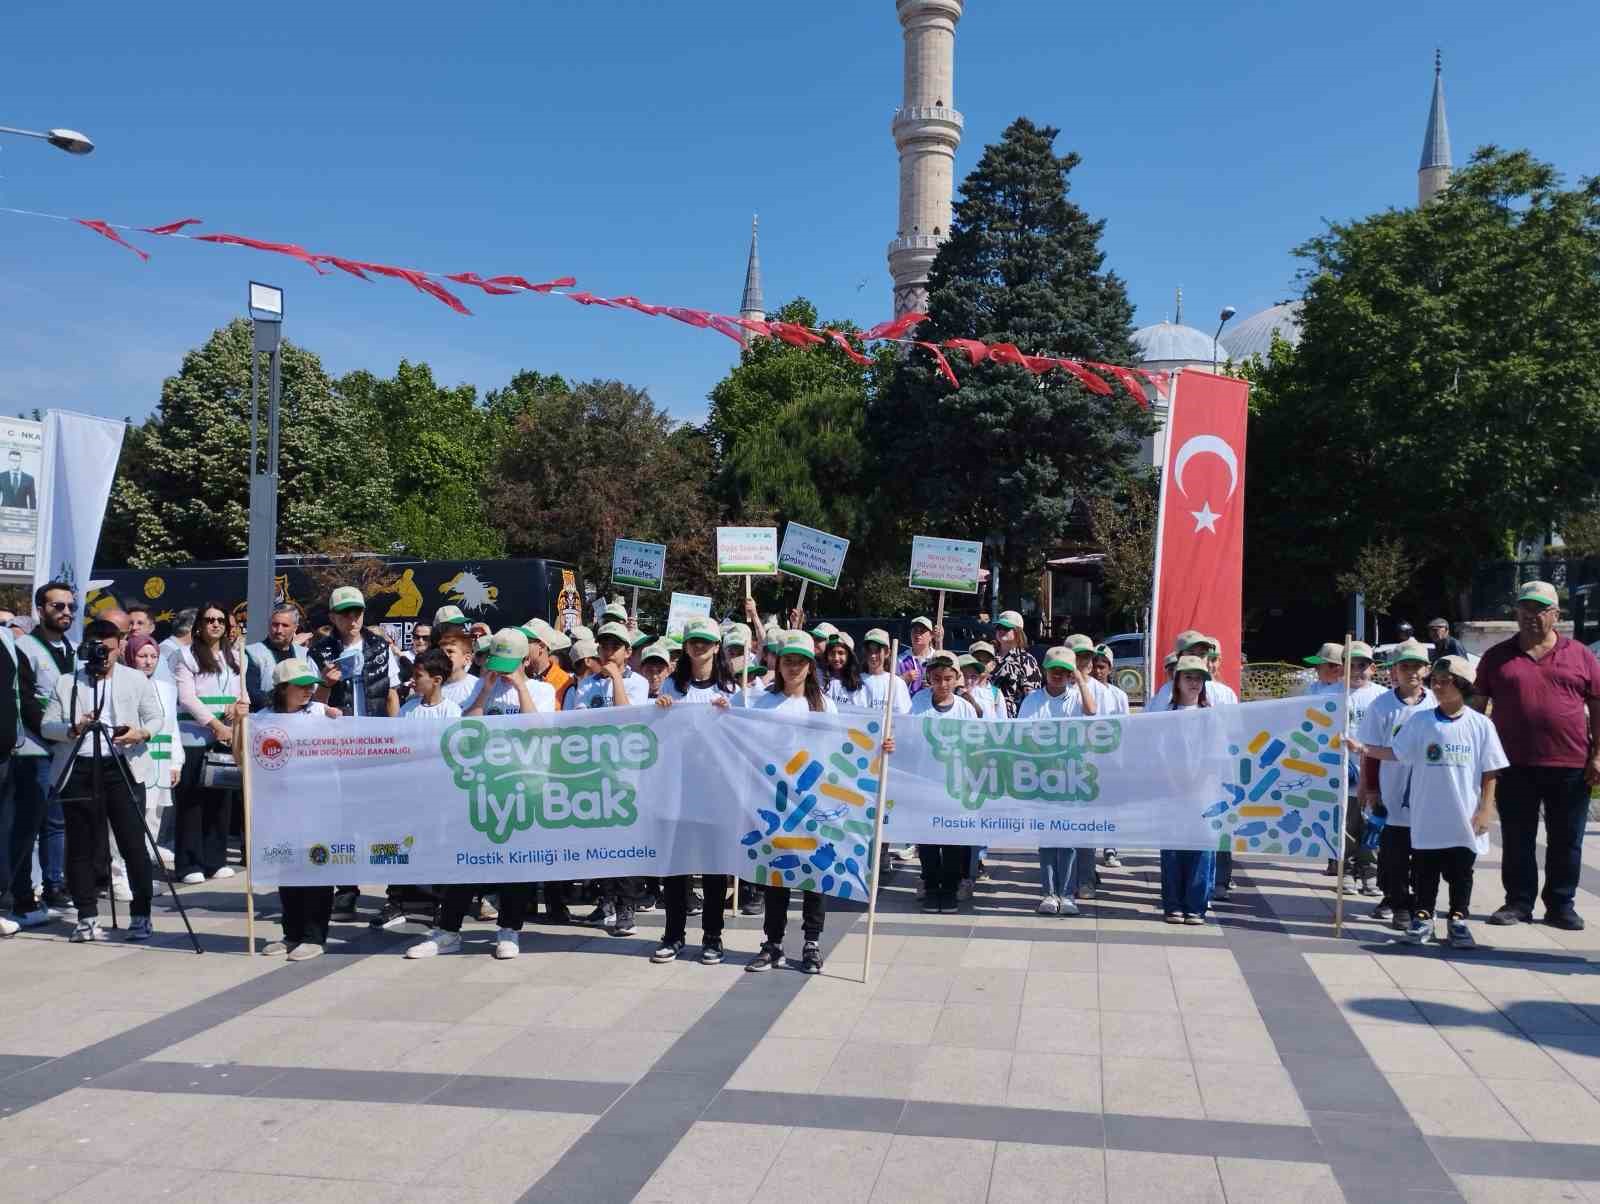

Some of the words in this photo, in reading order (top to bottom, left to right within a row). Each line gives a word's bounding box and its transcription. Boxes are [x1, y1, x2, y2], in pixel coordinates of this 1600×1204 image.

[929, 719, 1114, 749] Çevrene
[449, 727, 651, 781] Çevrene
[953, 750, 998, 802] İyi
[1013, 758, 1092, 795] Bak
[476, 773, 526, 835] İyi
[542, 777, 629, 821] Bak
[931, 816, 976, 829] Plastik
[981, 817, 1025, 832] Kirliliği
[1030, 819, 1045, 831] ile
[1050, 820, 1116, 832] Mücadele
[330, 843, 356, 855] SIFIR
[456, 850, 504, 865] Plastik
[509, 848, 558, 865] Kirliliği
[563, 847, 580, 861] ile
[586, 846, 657, 860] Mücadele
